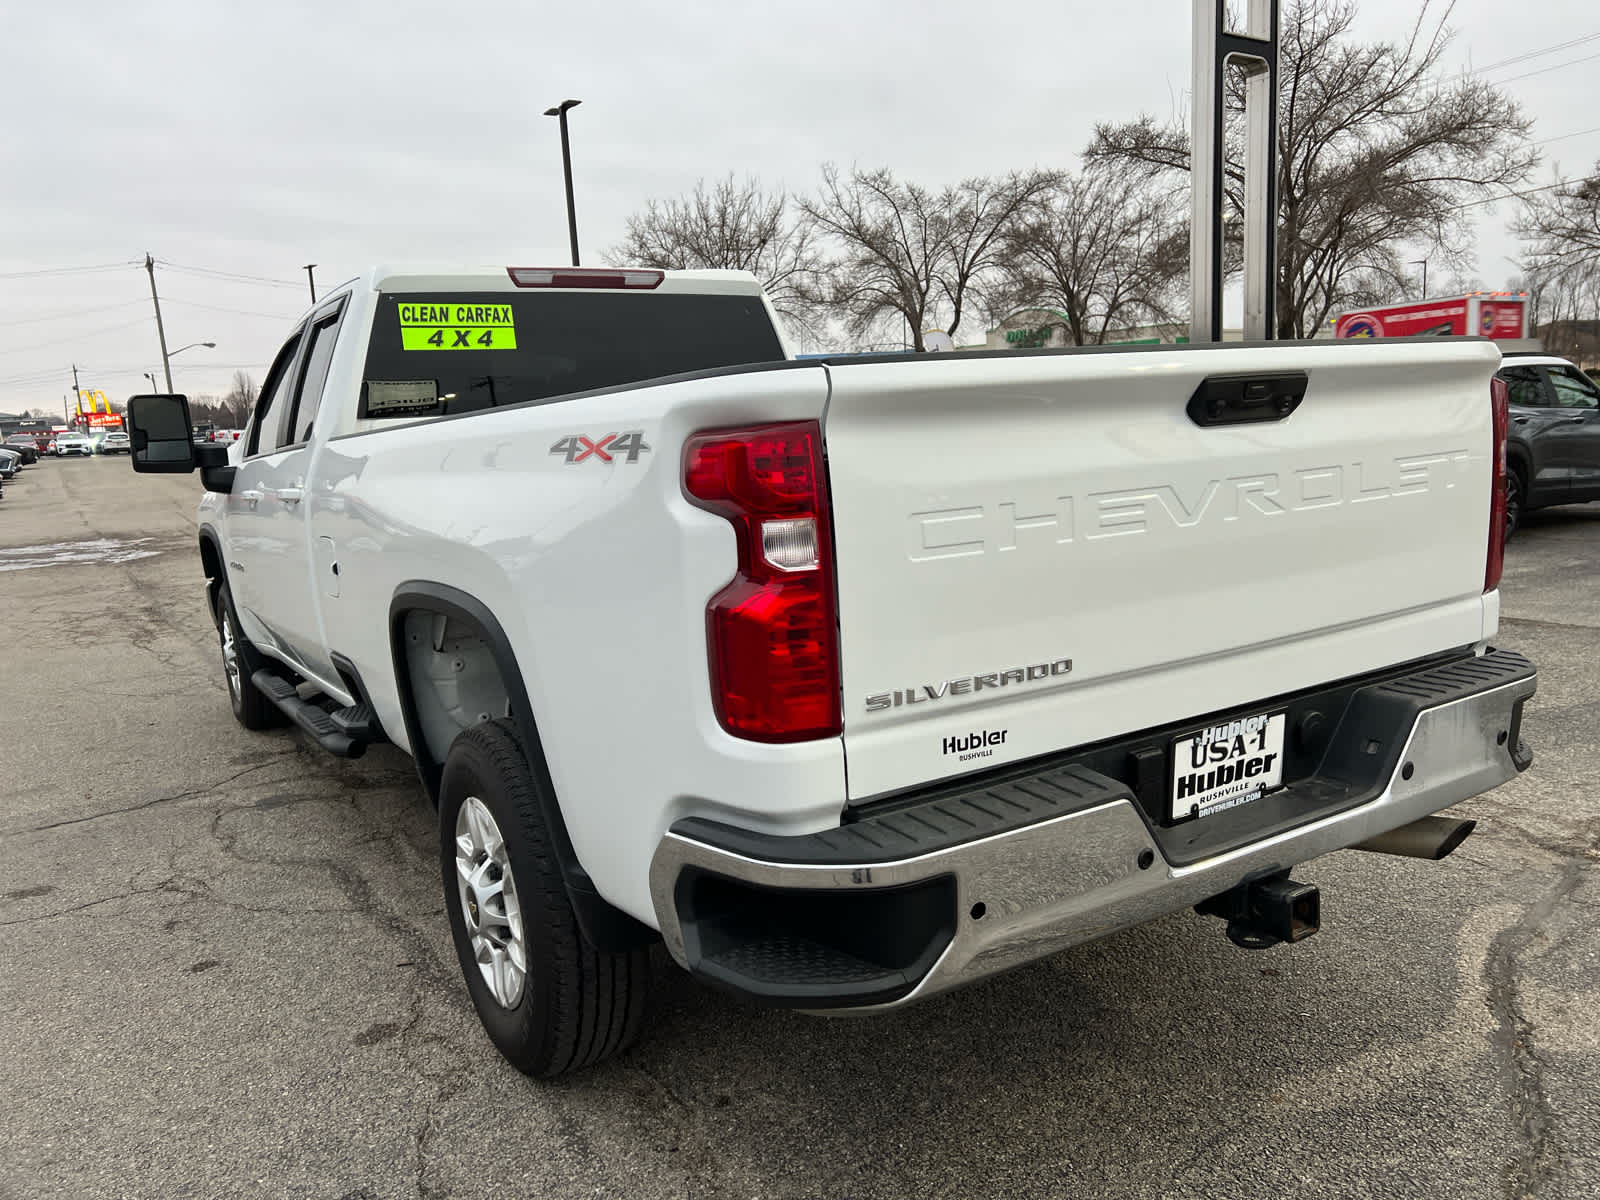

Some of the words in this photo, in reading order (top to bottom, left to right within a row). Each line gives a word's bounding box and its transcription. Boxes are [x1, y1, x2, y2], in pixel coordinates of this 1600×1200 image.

[401, 306, 449, 323] CLEAN
[456, 307, 511, 323] CARFAX
[908, 450, 1480, 562] CHEVROLET
[866, 658, 1073, 713] SILVERADO
[942, 729, 1008, 755] Hubler
[1201, 713, 1268, 745] Hubler
[958, 749, 993, 762] RUSHVILLE
[1190, 726, 1267, 769] USA-1
[1177, 752, 1277, 800] Hubler
[1199, 782, 1250, 805] RUSHVILLE
[1199, 791, 1262, 818] DRIVEHUBLER.COM
